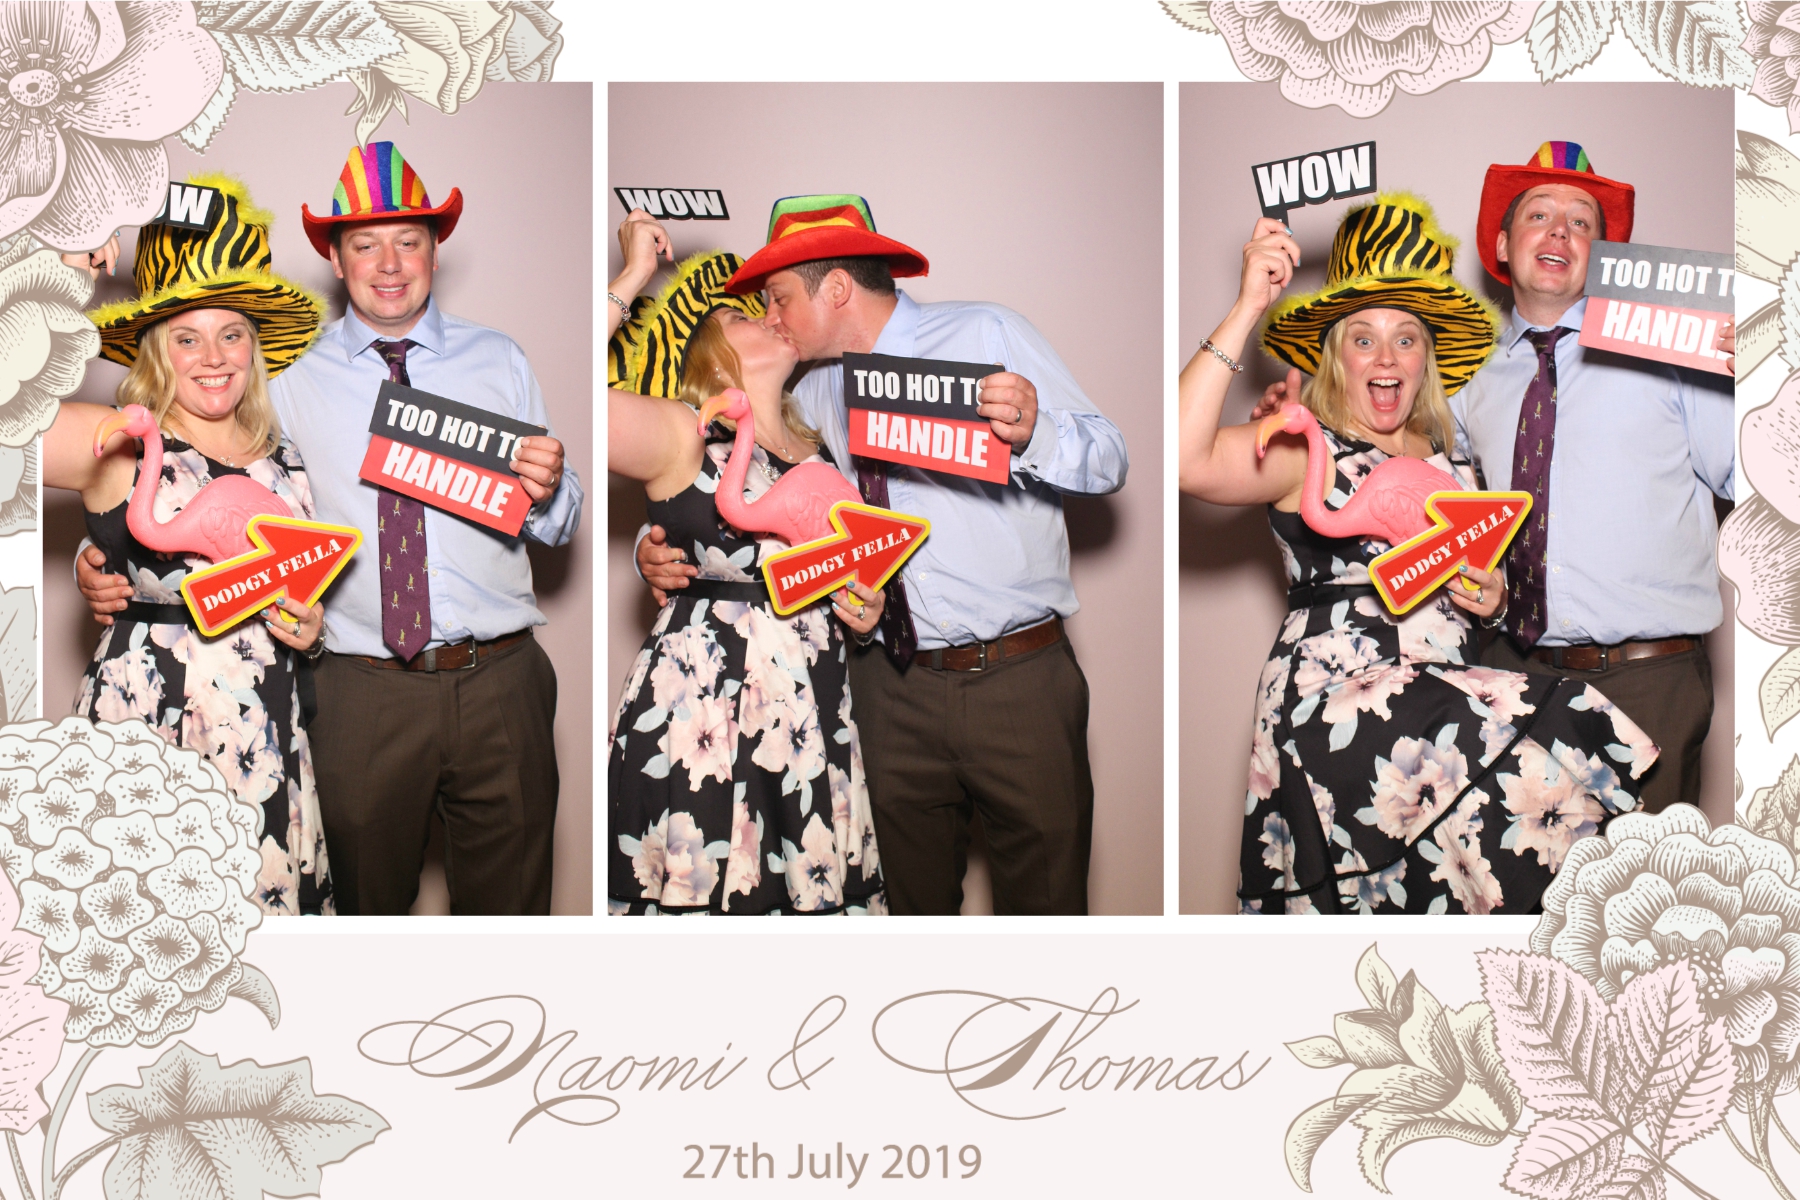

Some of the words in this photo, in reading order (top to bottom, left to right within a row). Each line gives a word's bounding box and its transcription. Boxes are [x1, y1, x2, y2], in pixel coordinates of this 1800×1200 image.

[619, 189, 724, 216] WOW
[1256, 145, 1370, 207] WOW
[1600, 257, 1652, 289] TOO
[1656, 262, 1713, 295] HOT
[1718, 268, 1735, 297] T
[1601, 300, 1735, 361] HANDL
[853, 369, 900, 400] TOO
[906, 373, 955, 404] HOT
[386, 399, 438, 437] TOO
[439, 415, 495, 453] HOT
[866, 411, 989, 468] HANDLE
[381, 441, 514, 518] HANDLE
[201, 568, 272, 612] DODGY
[276, 539, 342, 578] FELLA
[780, 553, 846, 591] DODGY
[851, 528, 911, 562] FELLA
[1389, 542, 1453, 591] DODGY
[1455, 505, 1515, 549] FELLA
